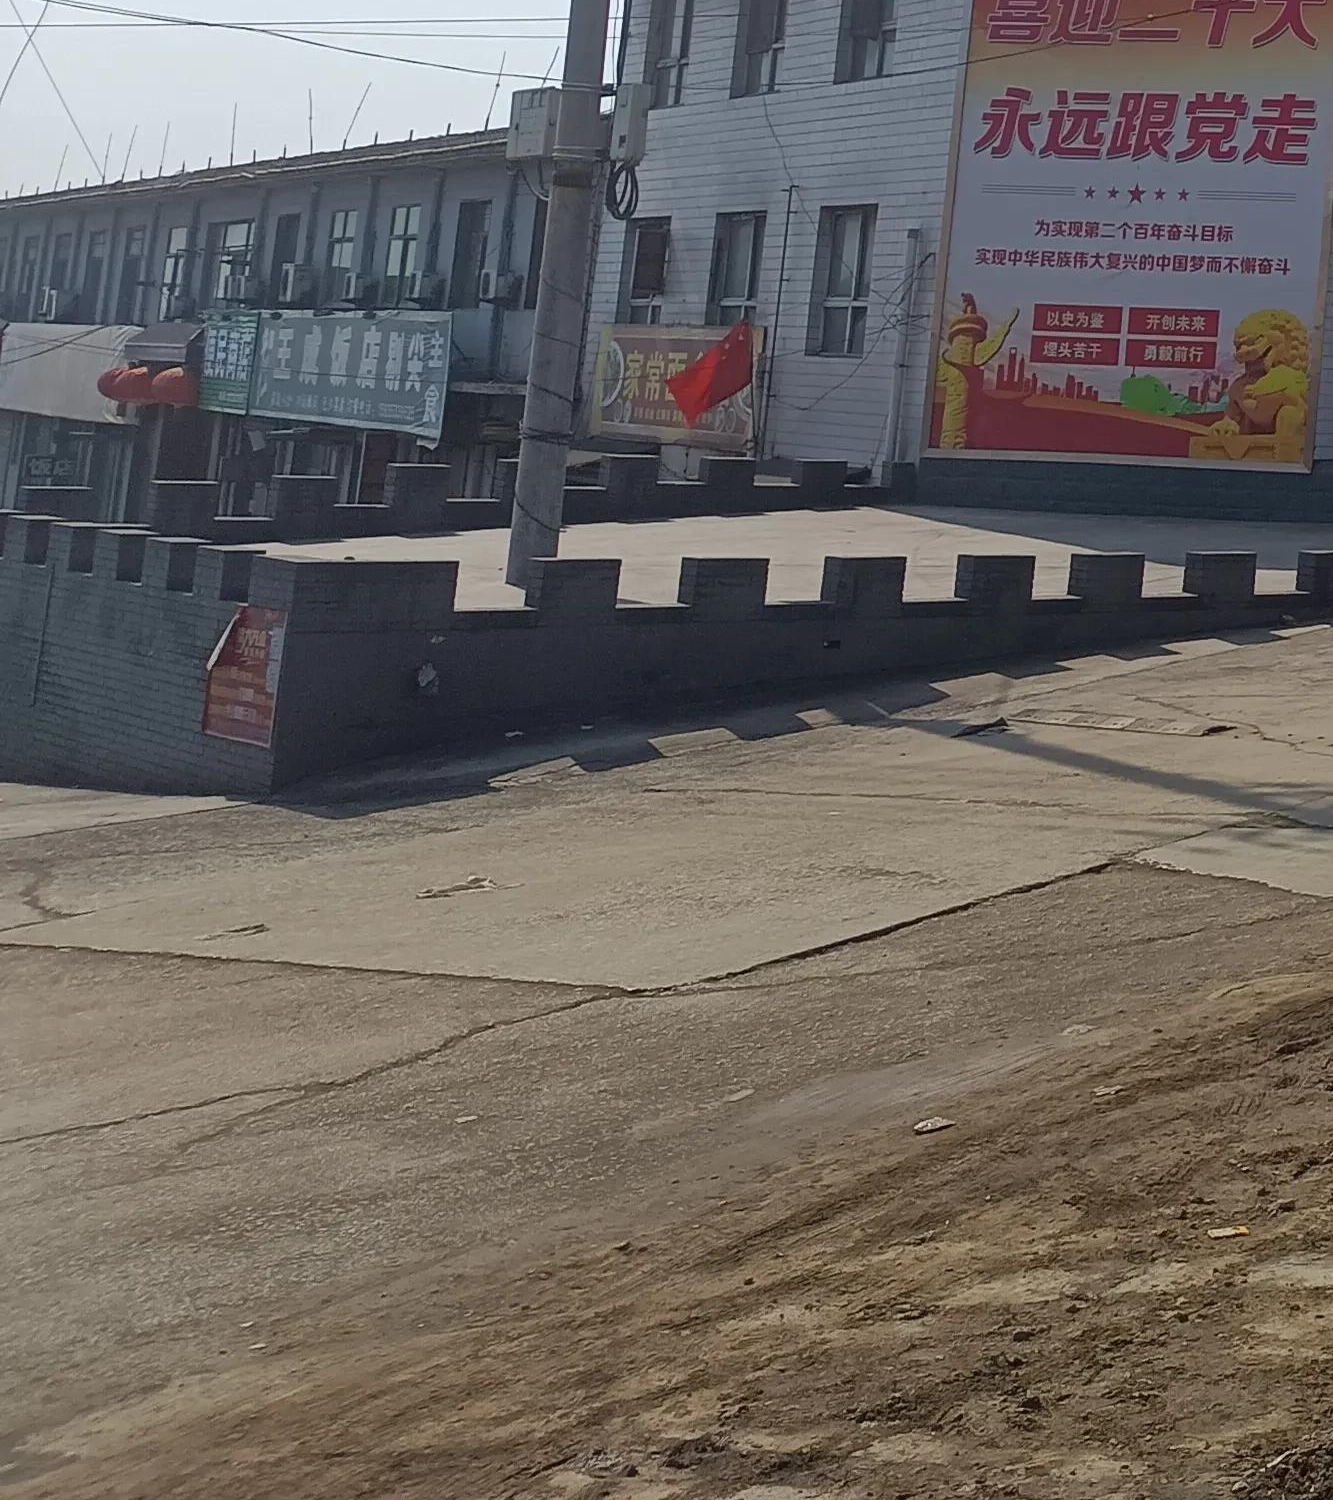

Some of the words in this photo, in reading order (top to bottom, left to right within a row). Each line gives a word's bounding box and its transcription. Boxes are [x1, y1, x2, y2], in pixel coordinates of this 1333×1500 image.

[973, 85, 1318, 165] 永远跟党走
[1033, 218, 1234, 243] 为实现第二个百年奋斗目标
[974, 247, 1291, 277] 实现中华民族伟大复兴的中国梦而不懈奋斗
[1045, 309, 1105, 329] 以史为鉴
[1145, 313, 1207, 332] 开创未来
[1042, 340, 1103, 360] 埋头苦干
[1143, 343, 1205, 363] 勇毅前行
